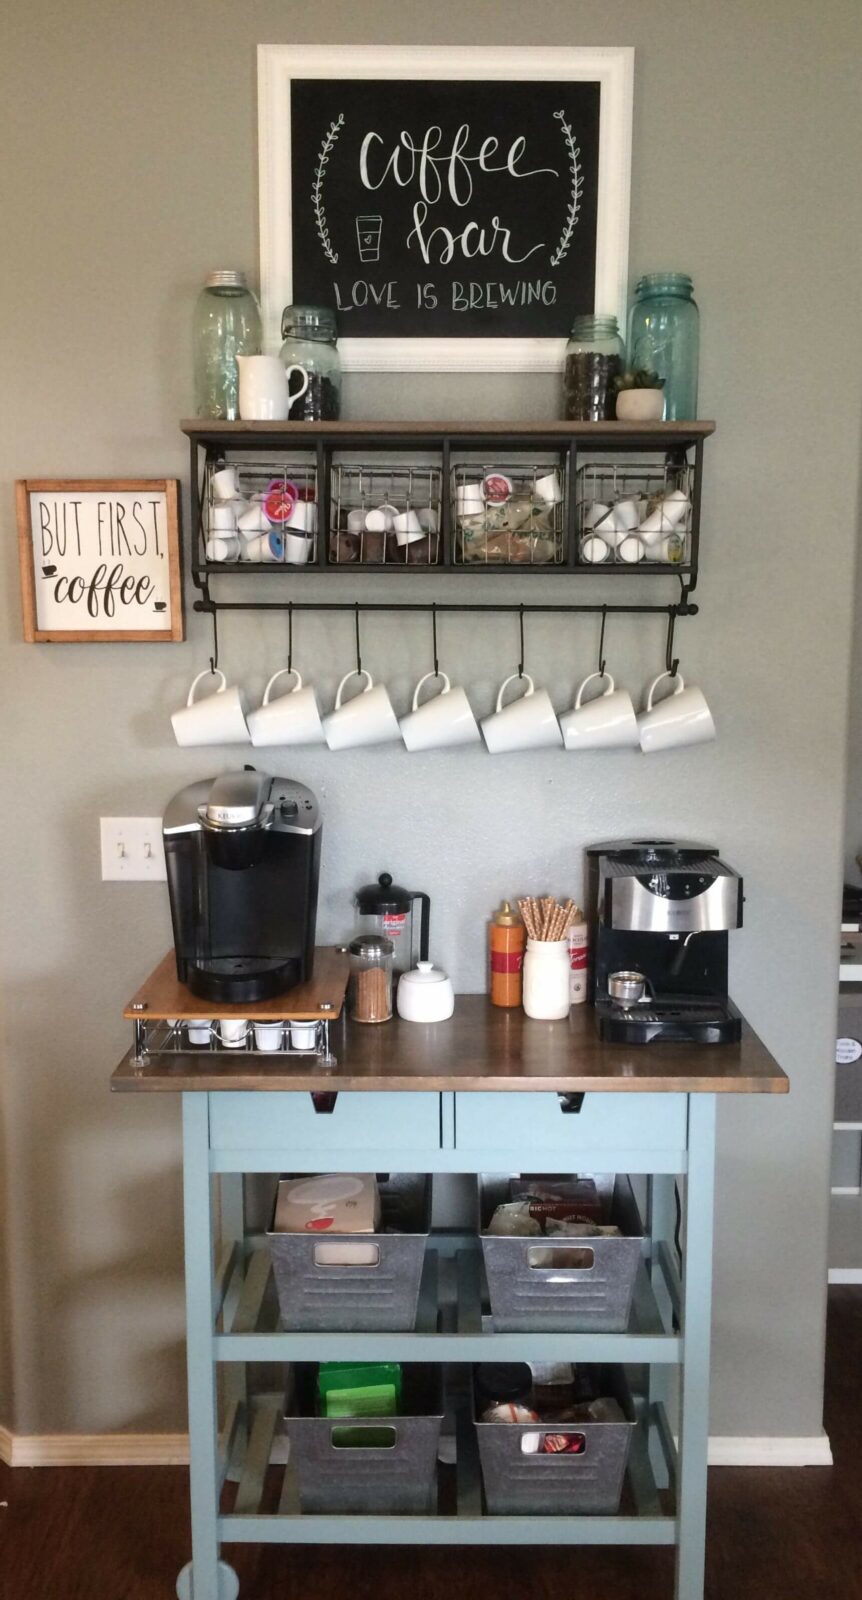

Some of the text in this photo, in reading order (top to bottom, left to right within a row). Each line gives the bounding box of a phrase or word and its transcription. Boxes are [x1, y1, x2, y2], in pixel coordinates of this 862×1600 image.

[359, 123, 559, 207] coffee
[406, 200, 546, 265] bar
[333, 279, 558, 312] LOVE IS BREWING
[39, 501, 165, 560] BUT FIRST,
[53, 563, 156, 618] coffee
